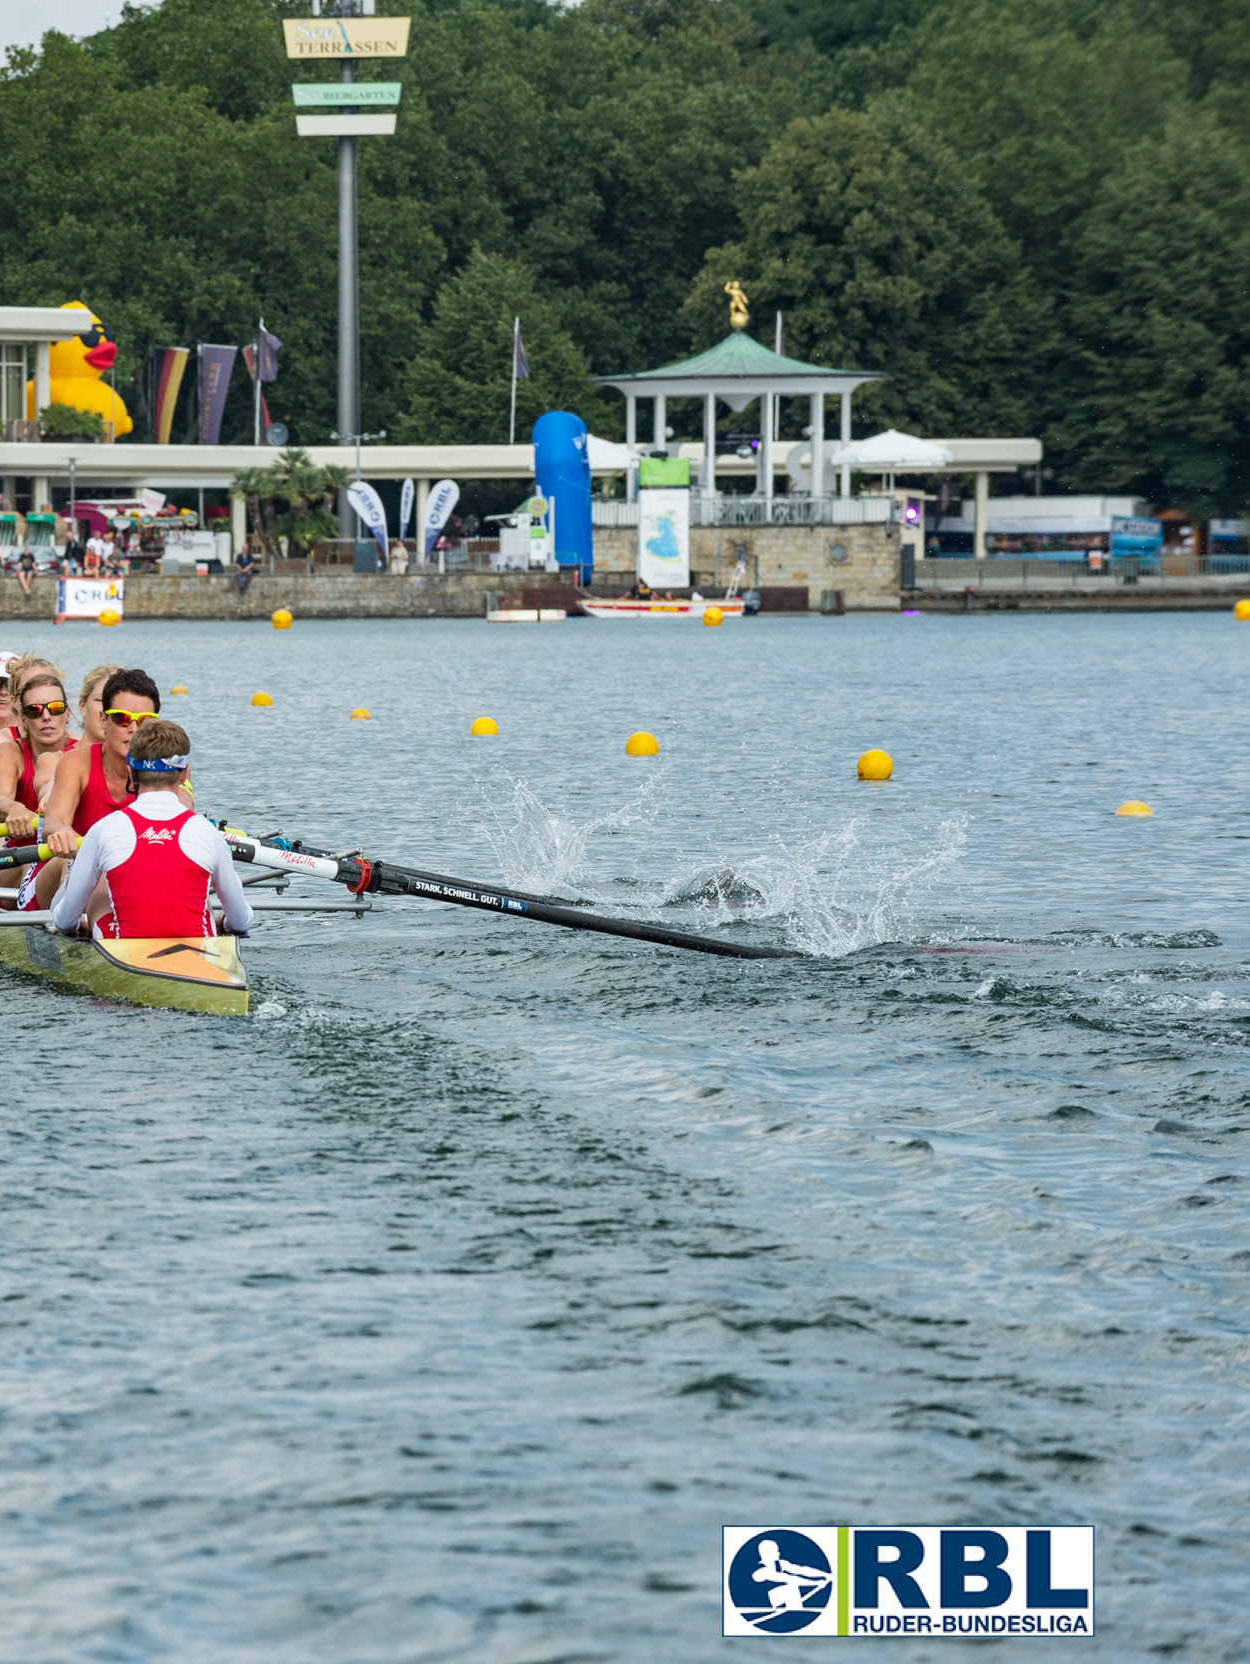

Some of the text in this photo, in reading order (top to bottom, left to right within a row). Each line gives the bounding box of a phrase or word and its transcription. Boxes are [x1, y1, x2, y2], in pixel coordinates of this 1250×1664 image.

[296, 21, 336, 41] See
[296, 42, 397, 53] TERRASSEN
[324, 91, 396, 100] BIERGARTEN
[143, 760, 156, 769] NK
[275, 850, 317, 869] Melitta
[415, 881, 523, 910] STARK. SCHNELL. GUT. RBL
